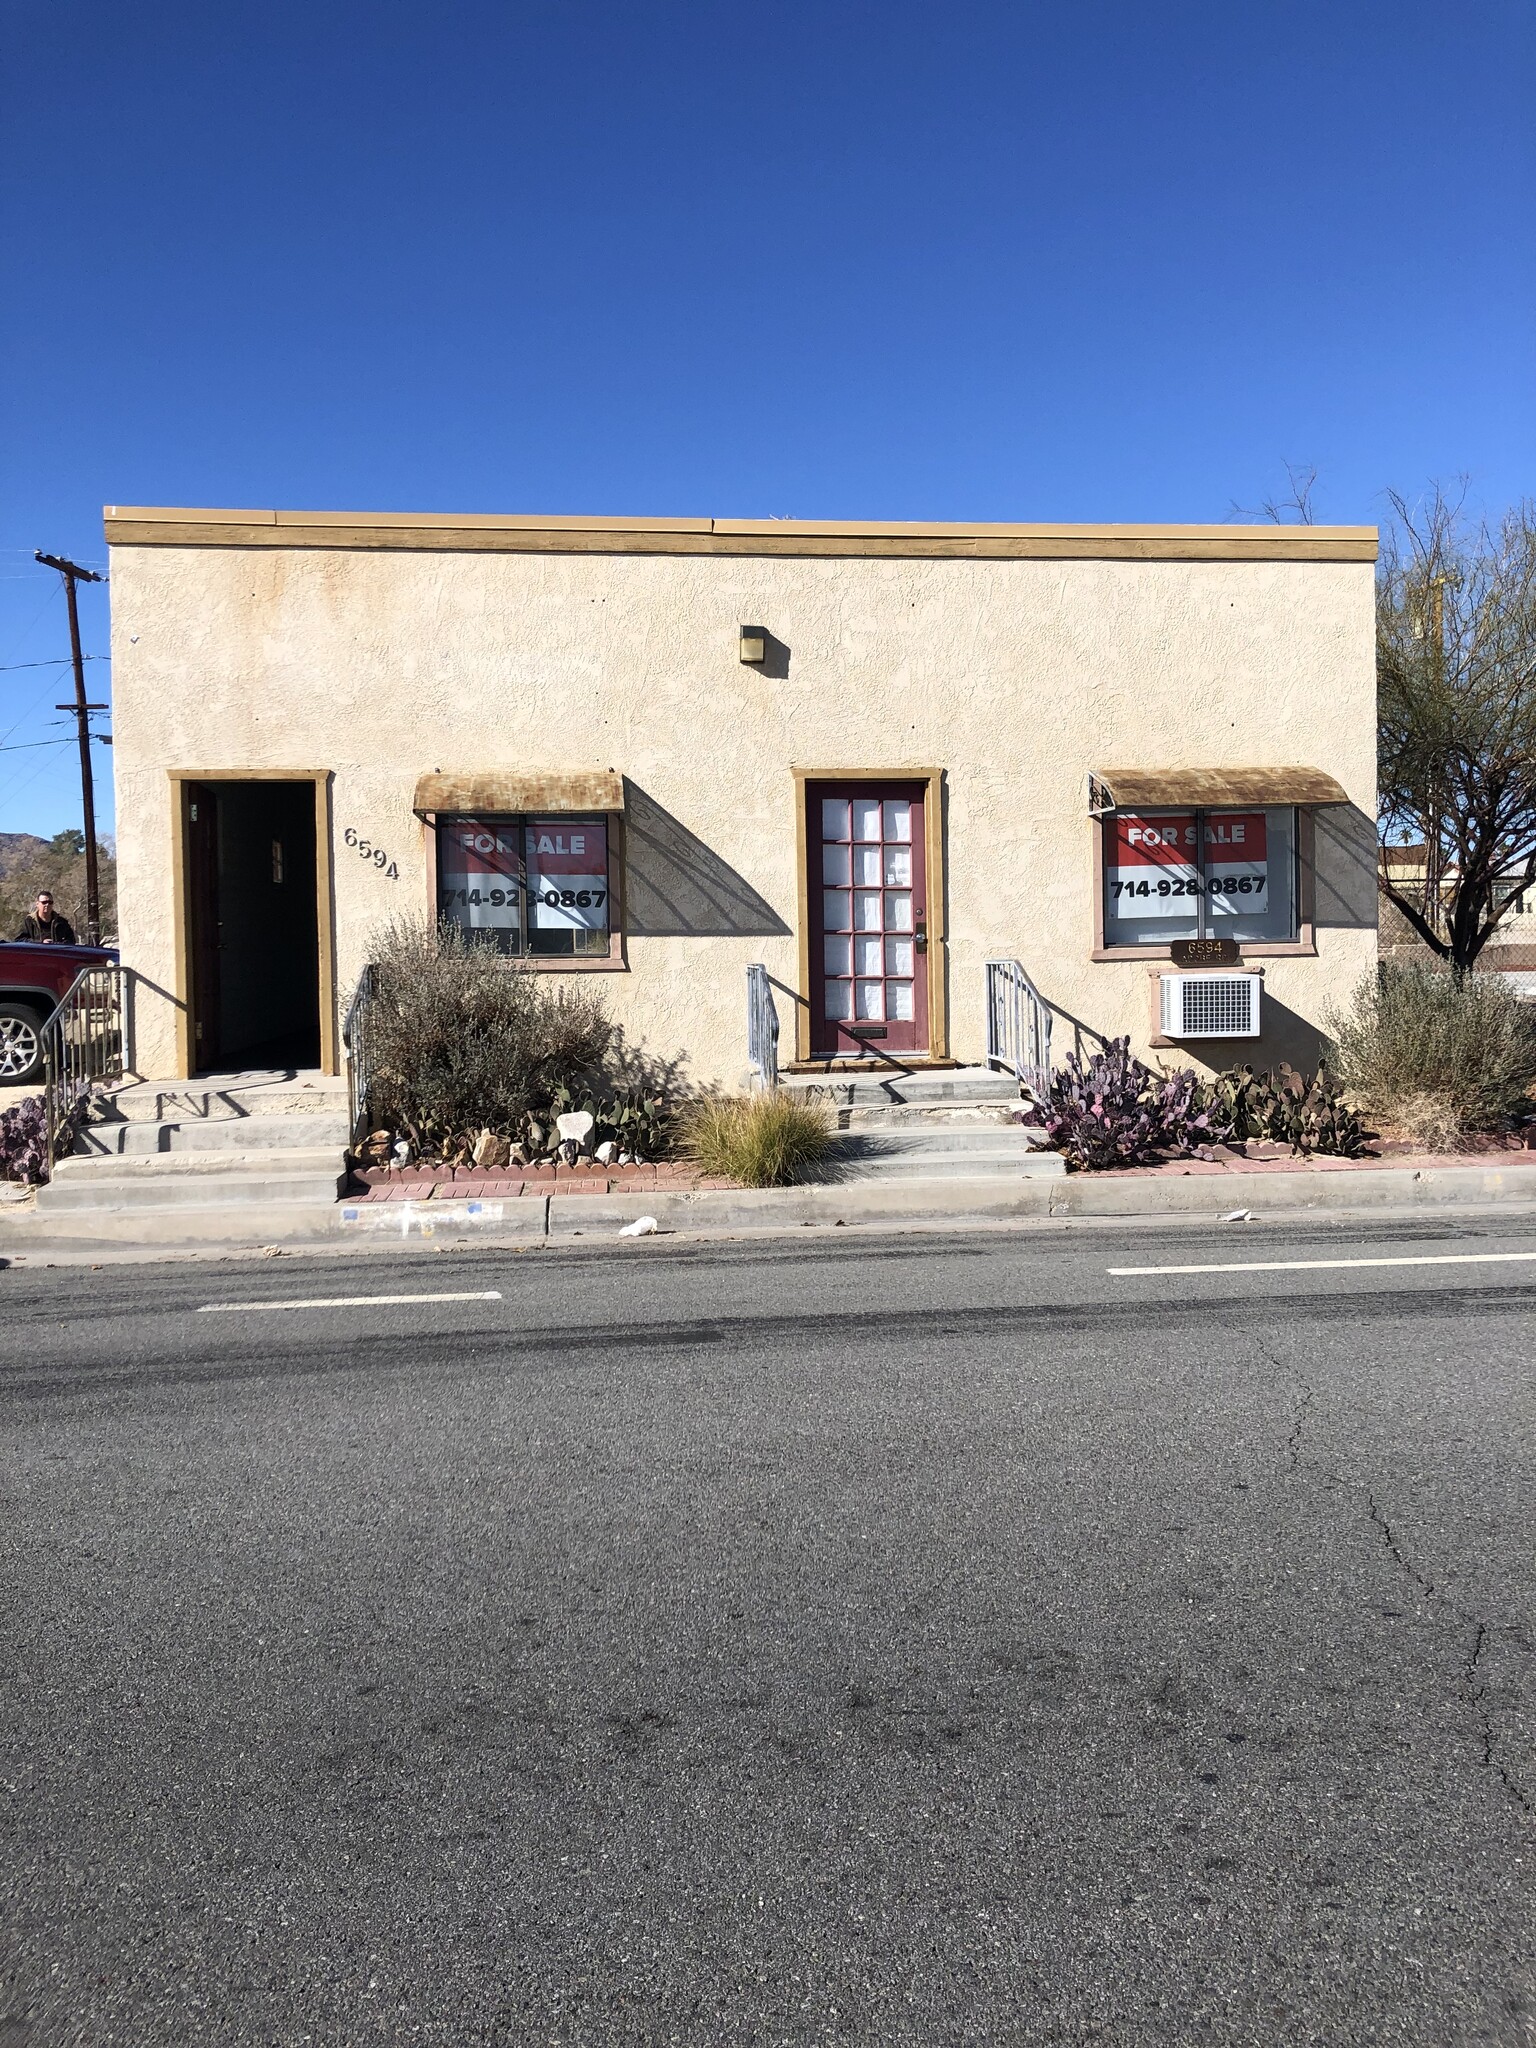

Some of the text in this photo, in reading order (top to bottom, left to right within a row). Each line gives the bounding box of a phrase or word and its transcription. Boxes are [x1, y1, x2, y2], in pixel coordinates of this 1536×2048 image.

[459, 833, 586, 855] FOR SALE
[1128, 824, 1245, 846] FOR SALE
[344, 827, 400, 880] 6594
[442, 888, 606, 908] 714-928-0867
[1188, 941, 1223, 954] 6594
